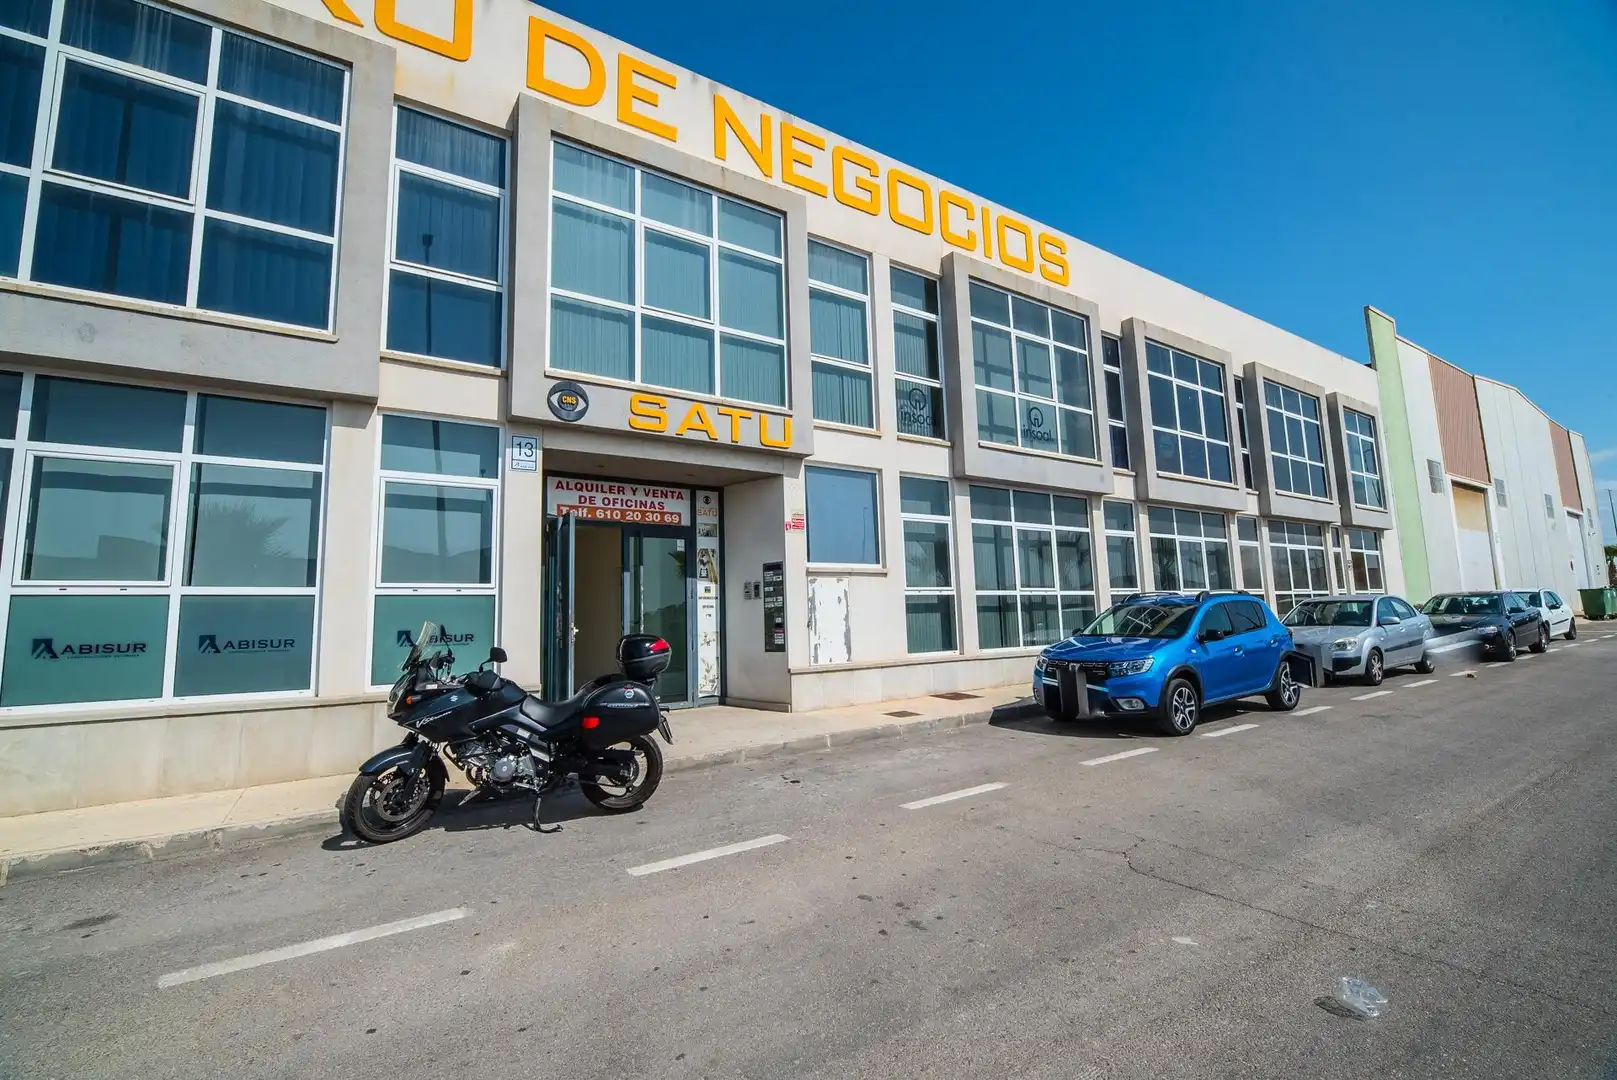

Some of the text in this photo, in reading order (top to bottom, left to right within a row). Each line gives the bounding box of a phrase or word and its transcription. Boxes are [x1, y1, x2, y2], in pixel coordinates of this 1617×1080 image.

[526, 15, 677, 142] DE
[713, 92, 1070, 287] NEGOCIOS
[628, 393, 793, 449] SATU
[516, 441, 534, 458] 13
[555, 480, 684, 500] ALQUILER Y VENTA
[578, 495, 665, 511] DE OFICINAS
[595, 508, 621, 520] 610
[625, 511, 641, 521] 20
[645, 512, 660, 523] 30
[664, 513, 680, 524] 69
[61, 643, 147, 655] ABISUR
[223, 638, 296, 650] ABISUR
